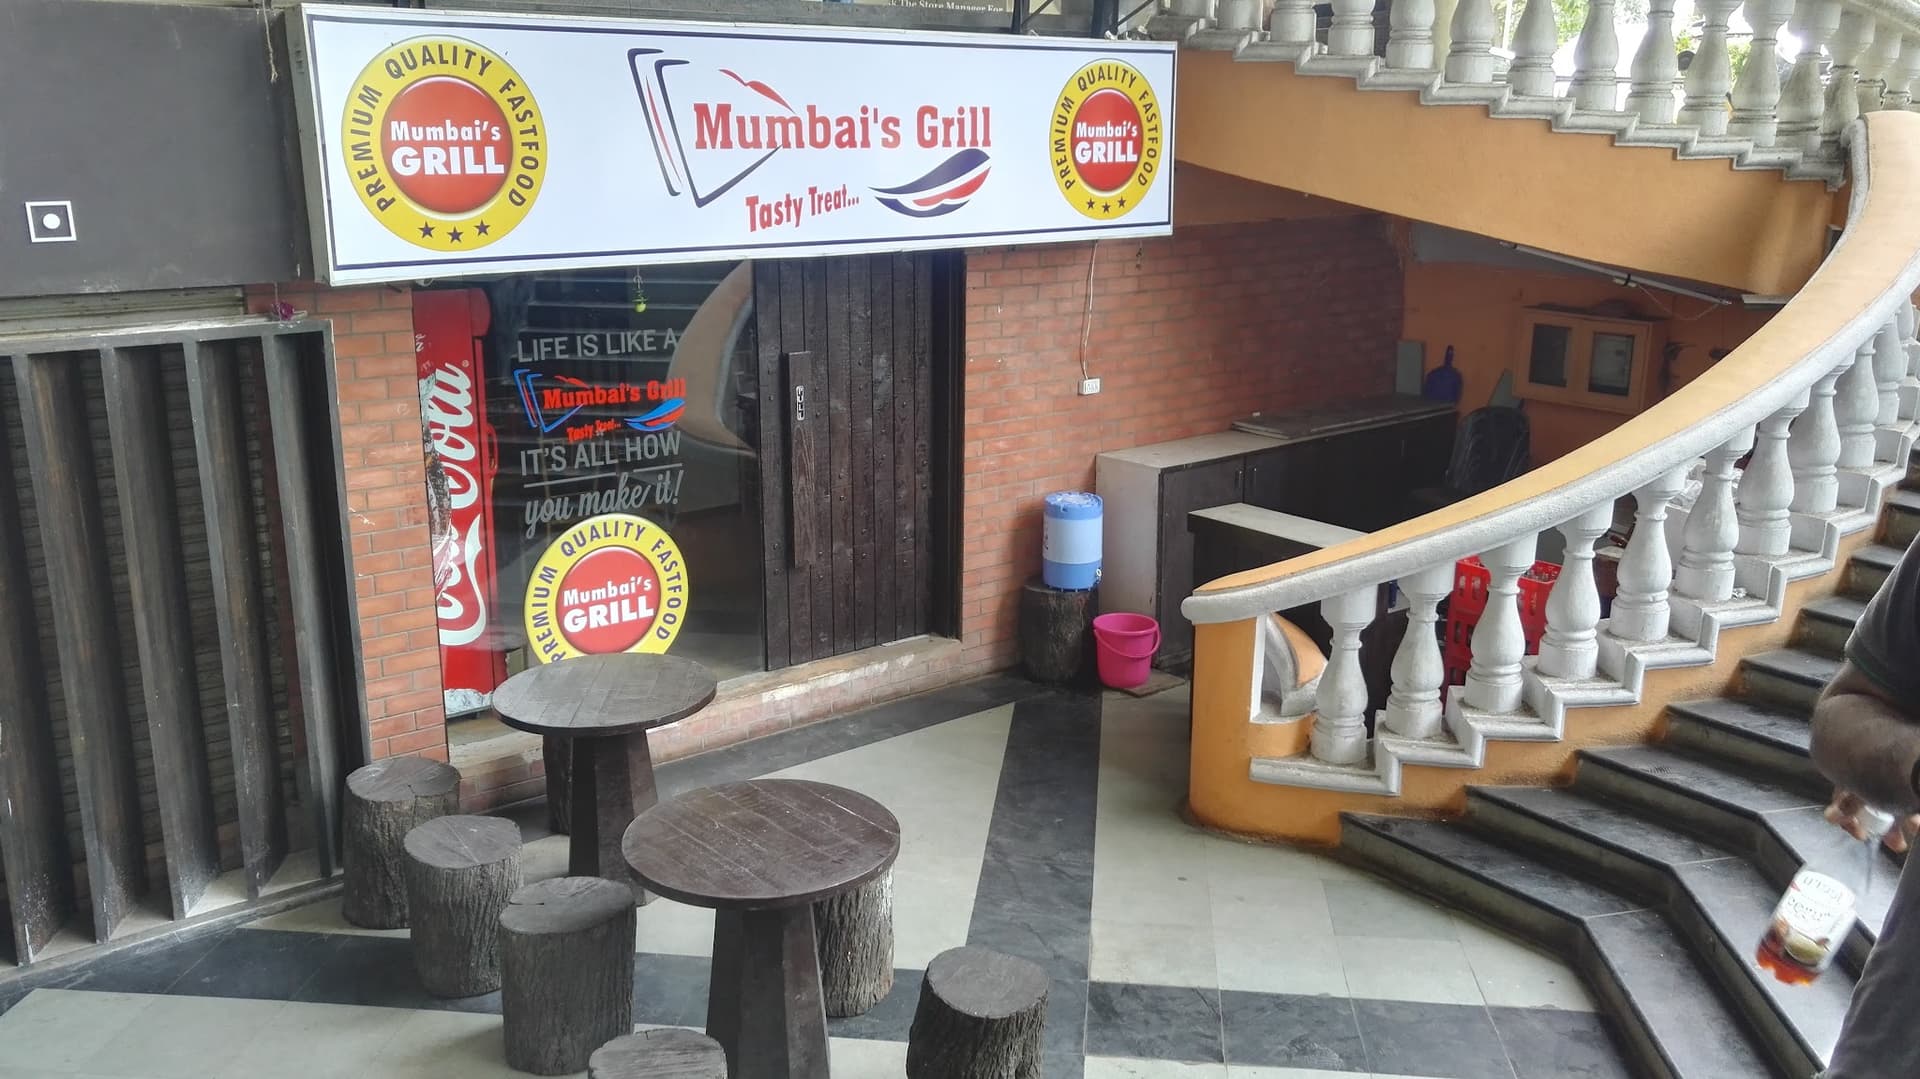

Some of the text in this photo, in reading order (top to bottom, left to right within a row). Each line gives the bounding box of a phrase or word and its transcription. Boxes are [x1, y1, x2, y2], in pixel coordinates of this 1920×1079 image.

[350, 44, 540, 212] PREMIUM QUALITY FASTFOOD
[390, 119, 502, 141] Mumbai's
[693, 102, 992, 149] Mumbai's Grill
[1055, 64, 1159, 190] PREMIUM QUALITY FASTFOOD
[1076, 120, 1138, 138] Mumbai's
[391, 146, 505, 176] GRILL
[1075, 140, 1138, 164] GRILL
[745, 183, 860, 232] Tasty Treat...
[517, 327, 679, 363] LIFE IS LIKE A
[543, 377, 687, 409] Mumbai's Grill
[520, 431, 681, 476] IT'S ALL HOW
[525, 469, 684, 539] you make it!
[532, 521, 682, 663] PREMIUM QUALITY FASTFOOD
[563, 576, 652, 607] Mumbai's
[563, 595, 654, 633] GRILL
